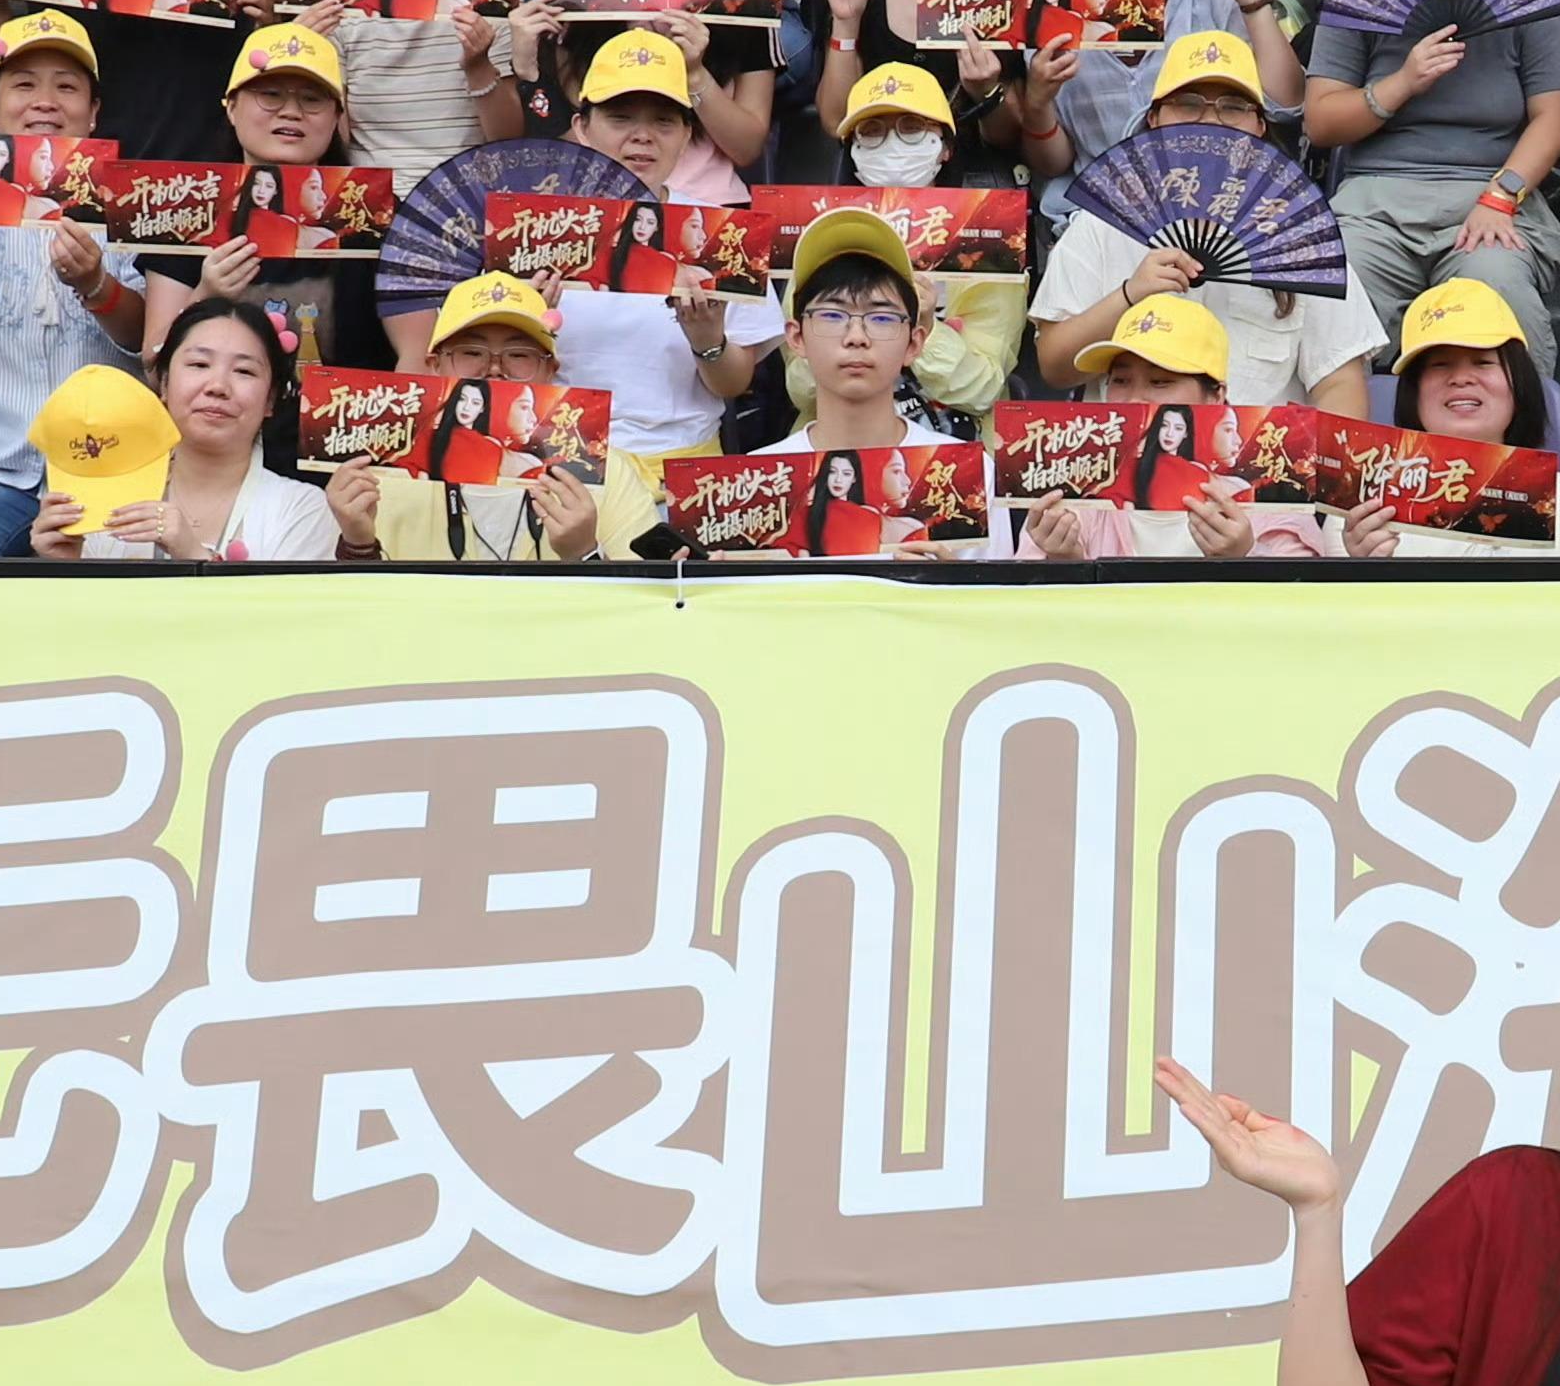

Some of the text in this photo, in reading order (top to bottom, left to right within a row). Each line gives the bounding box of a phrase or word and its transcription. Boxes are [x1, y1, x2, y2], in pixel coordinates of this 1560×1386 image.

[115, 172, 220, 208] 开机大吉
[497, 205, 601, 241] 开机大吉
[885, 206, 954, 249] 丽君
[313, 384, 422, 429] 开机大吉
[1005, 411, 1126, 456] 开机大吉
[680, 460, 794, 511] 开机大吉
[1347, 443, 1476, 503] 陈丽君
